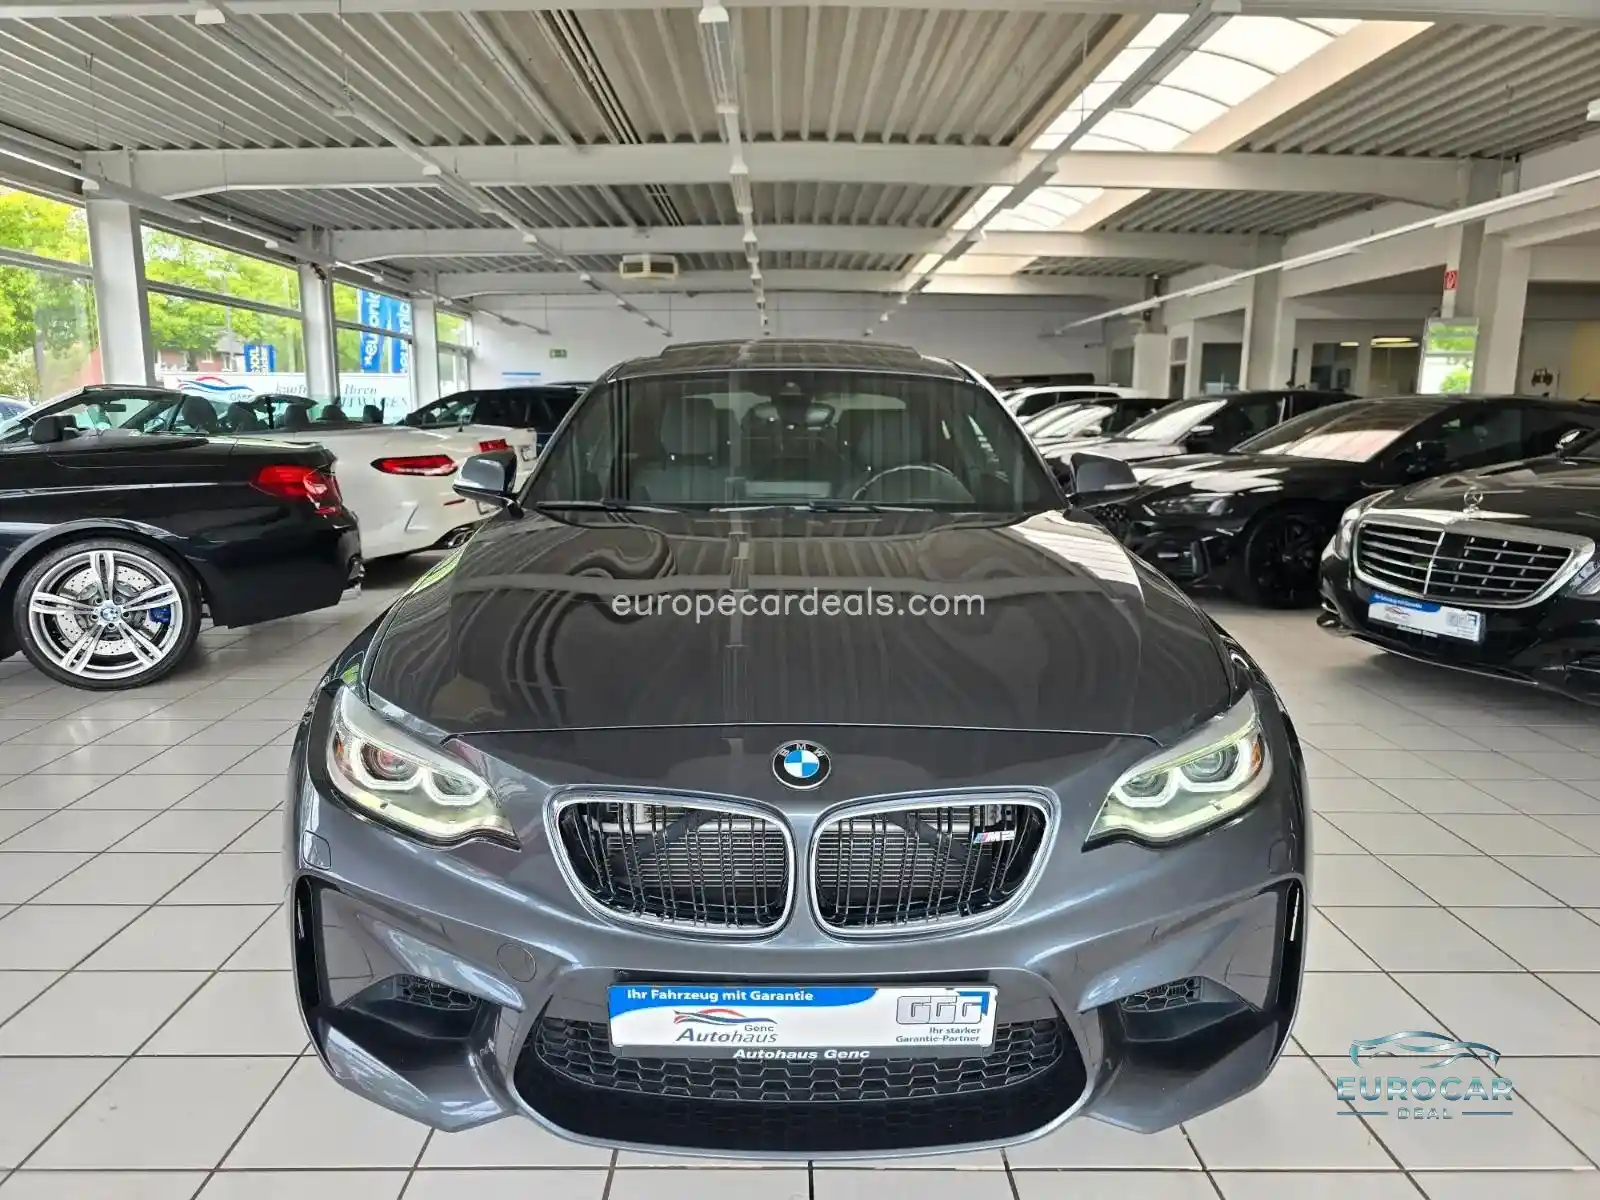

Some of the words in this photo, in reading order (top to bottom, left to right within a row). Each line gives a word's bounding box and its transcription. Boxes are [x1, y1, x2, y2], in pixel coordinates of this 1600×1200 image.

[779, 742, 826, 758] BMW
[627, 988, 648, 999] Ihr
[651, 989, 719, 1003] Fahrzeug
[722, 990, 747, 1001] mit
[750, 990, 814, 1001] Garantie
[744, 1024, 774, 1032] Genc
[929, 1026, 943, 1034] Ihr
[675, 1028, 778, 1043] Autohaus
[895, 1035, 980, 1043] Garantie-Partner
[733, 1049, 817, 1059] Autohaus
[824, 1050, 870, 1059] Genc
